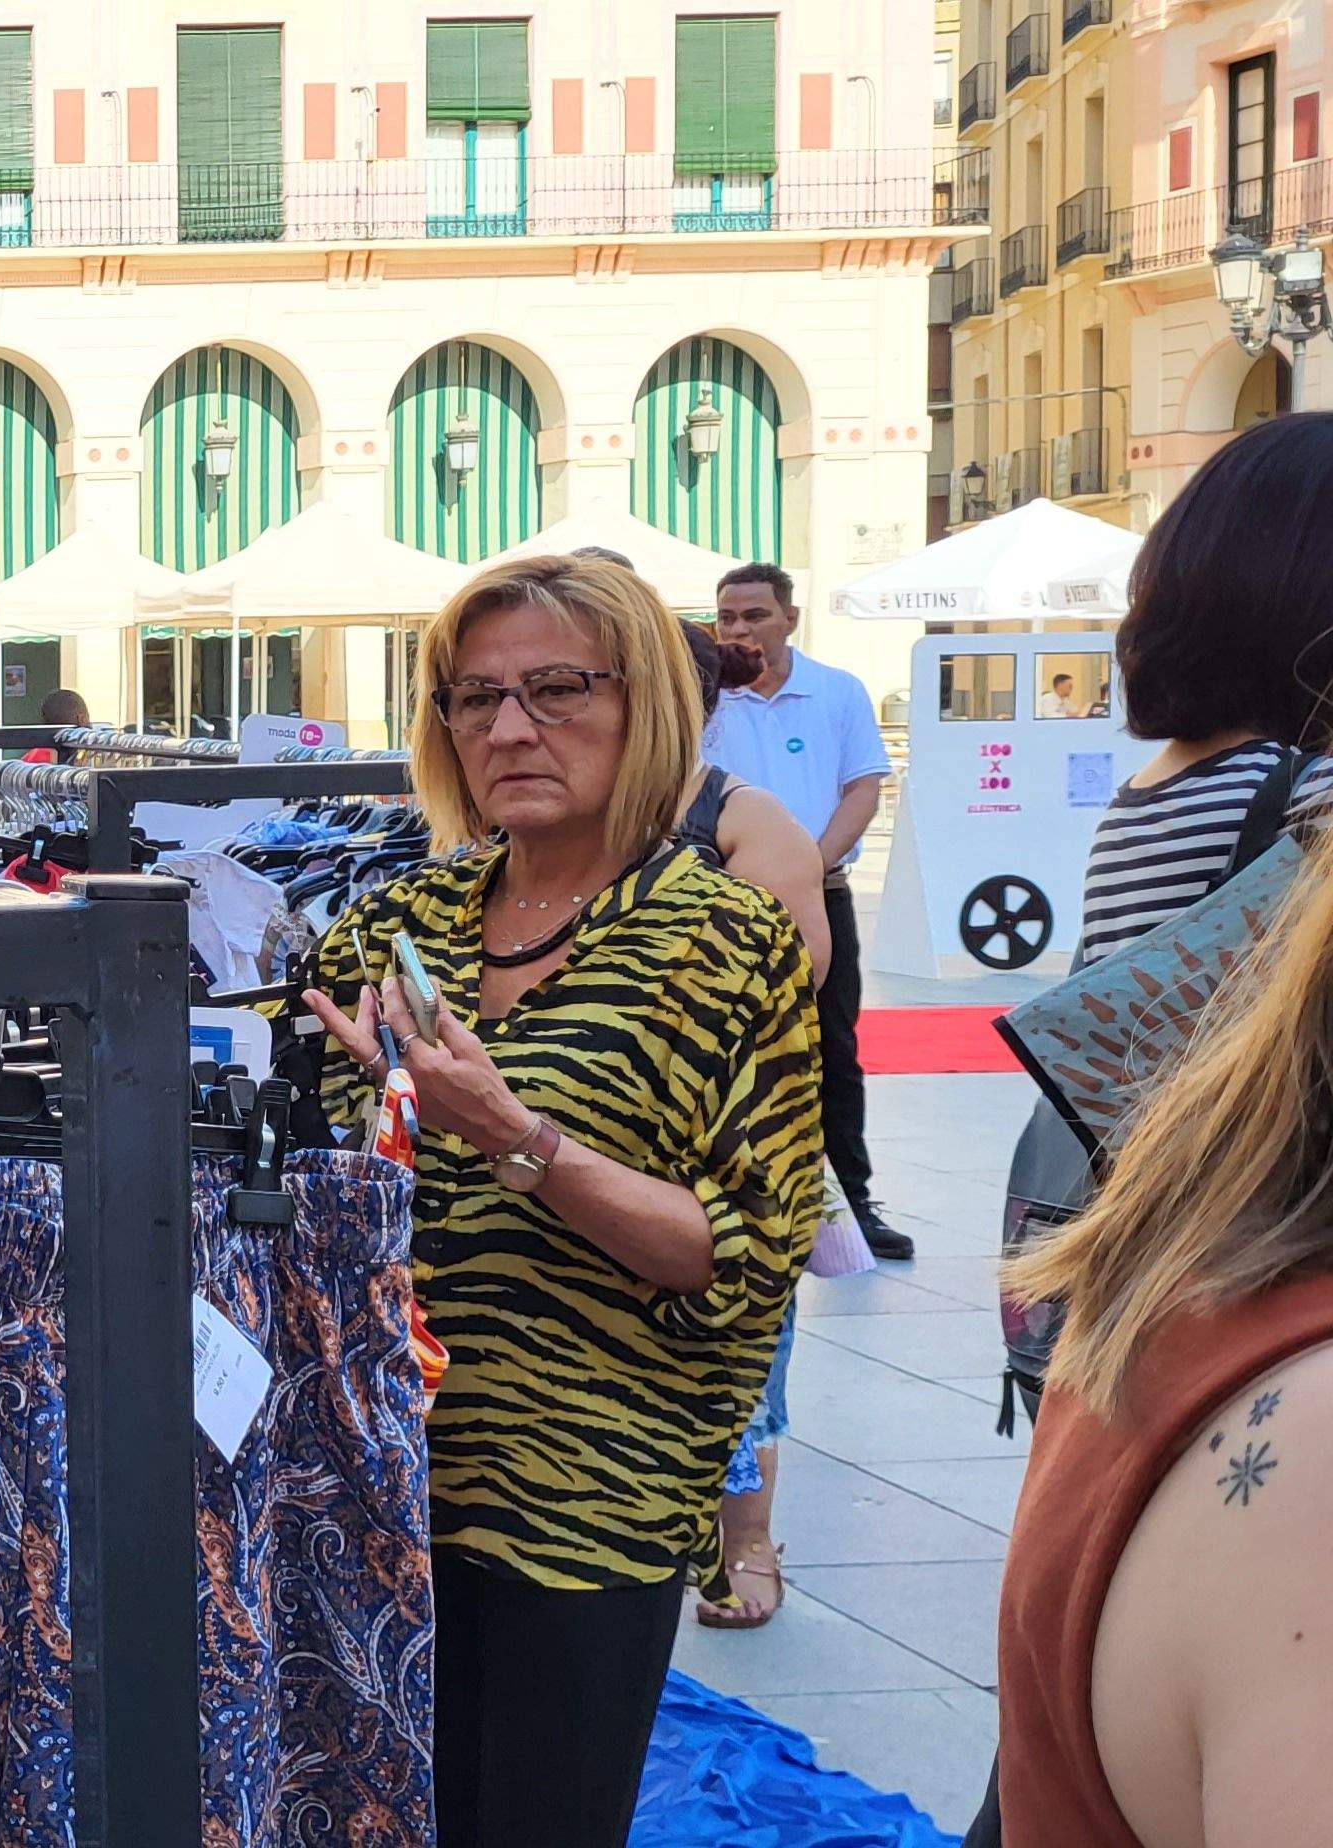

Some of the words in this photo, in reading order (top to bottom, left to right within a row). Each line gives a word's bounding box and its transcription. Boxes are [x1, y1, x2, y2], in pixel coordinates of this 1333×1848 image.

[895, 593, 958, 608] VELTINS
[268, 727, 296, 739] moda
[981, 744, 1011, 756] 100
[980, 777, 1010, 789] 100
